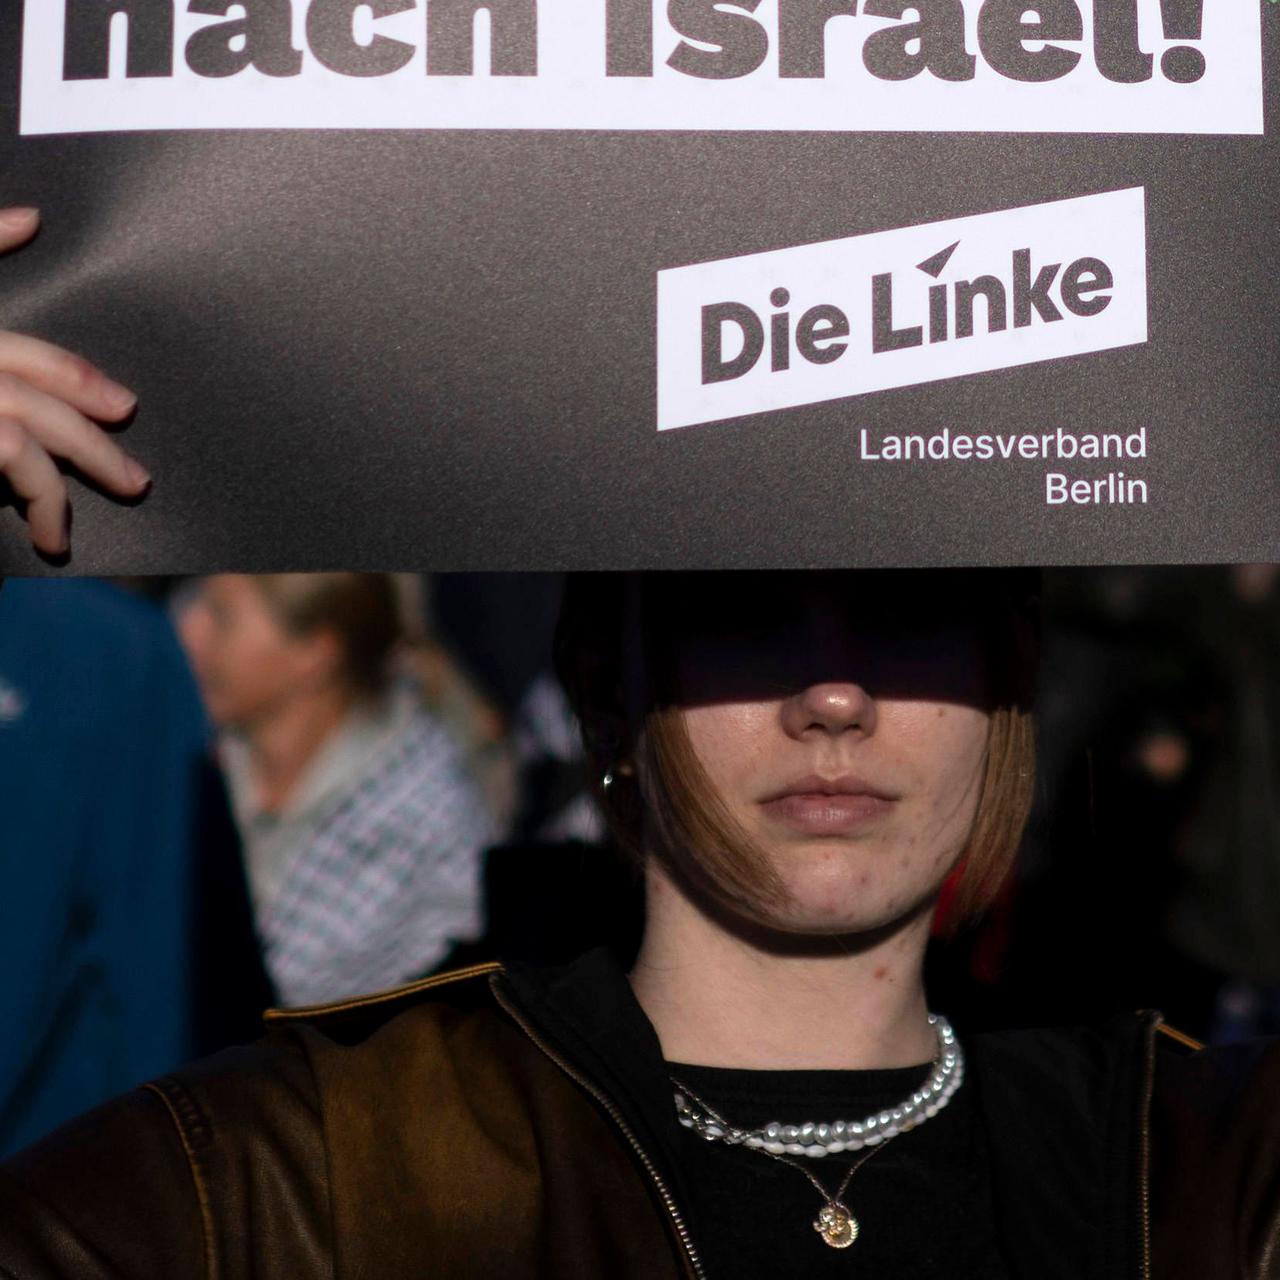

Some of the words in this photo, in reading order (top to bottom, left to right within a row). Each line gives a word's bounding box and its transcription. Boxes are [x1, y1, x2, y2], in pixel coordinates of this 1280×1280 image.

[701, 287, 850, 386] Die
[872, 240, 1114, 354] Linke
[860, 427, 1147, 460] Landesverband
[1046, 473, 1148, 505] Berlin
